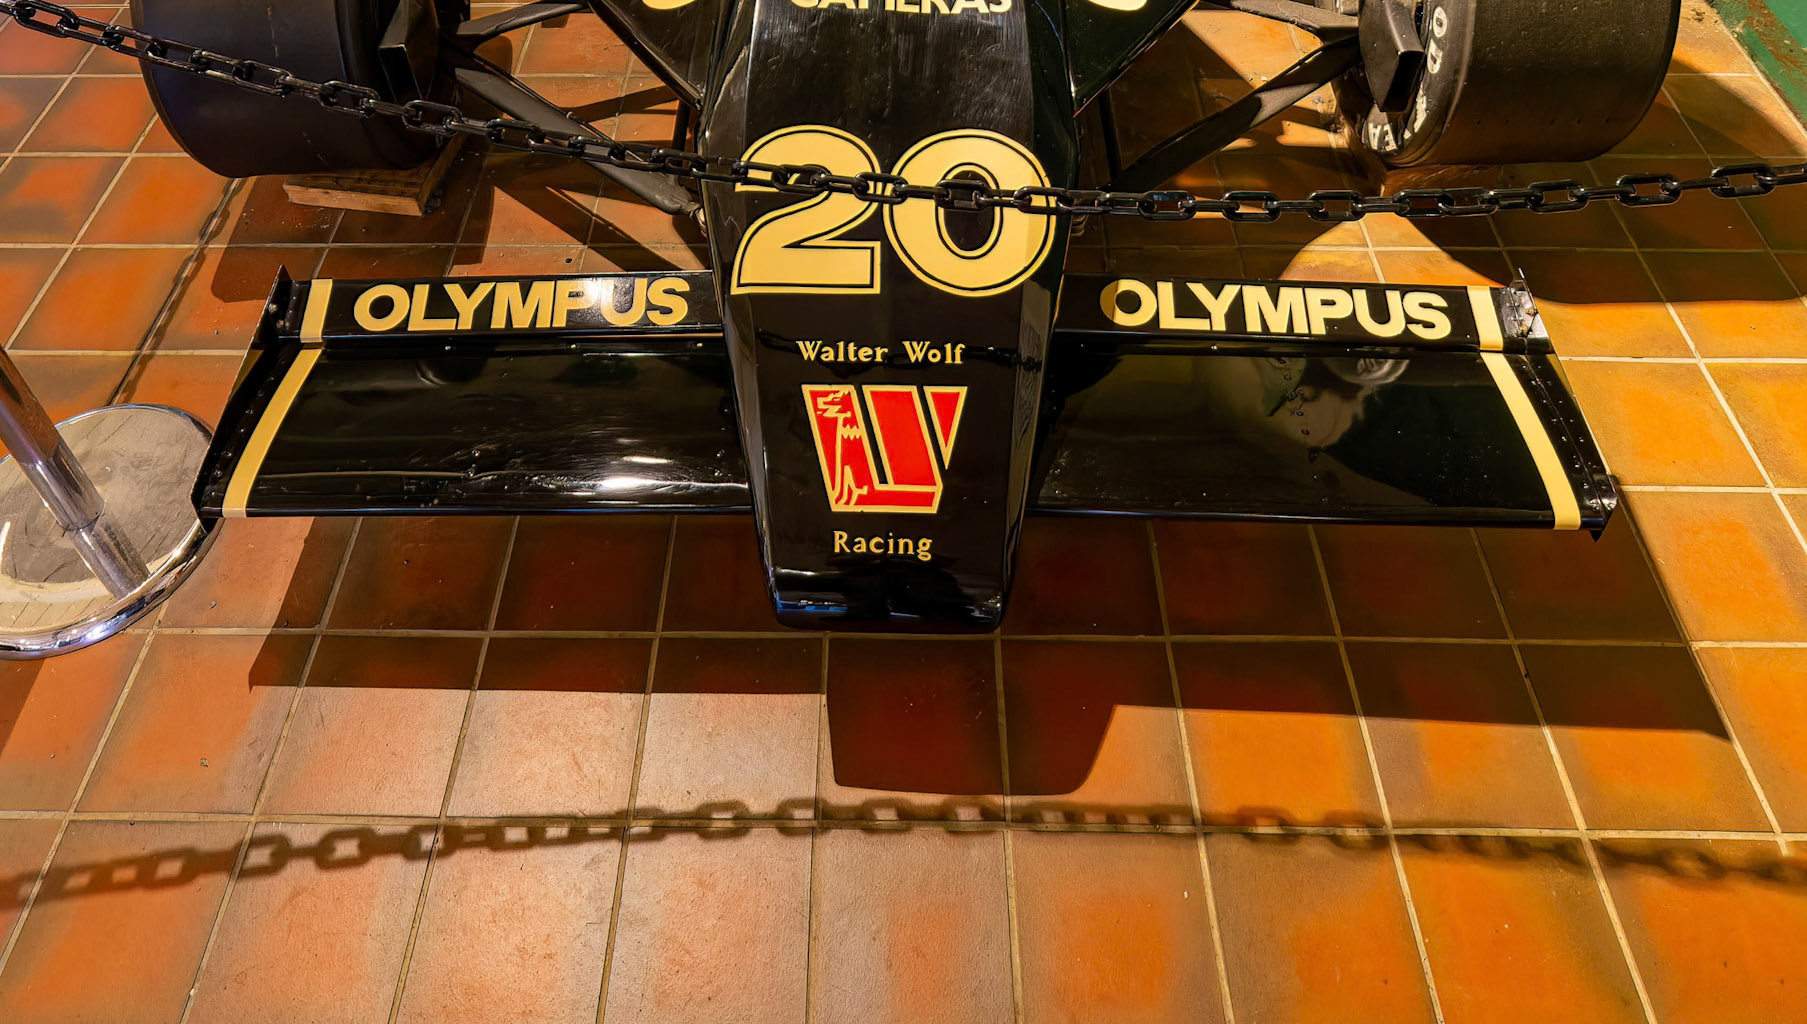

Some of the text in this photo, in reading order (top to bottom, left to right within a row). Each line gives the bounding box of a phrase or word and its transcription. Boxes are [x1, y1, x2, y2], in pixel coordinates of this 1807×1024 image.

[729, 124, 1057, 298] 20
[353, 277, 691, 332] OLYMPUS
[1099, 278, 1452, 341] OLYMPUS
[796, 340, 966, 364] Walter Wolf
[833, 530, 933, 562] Racing
